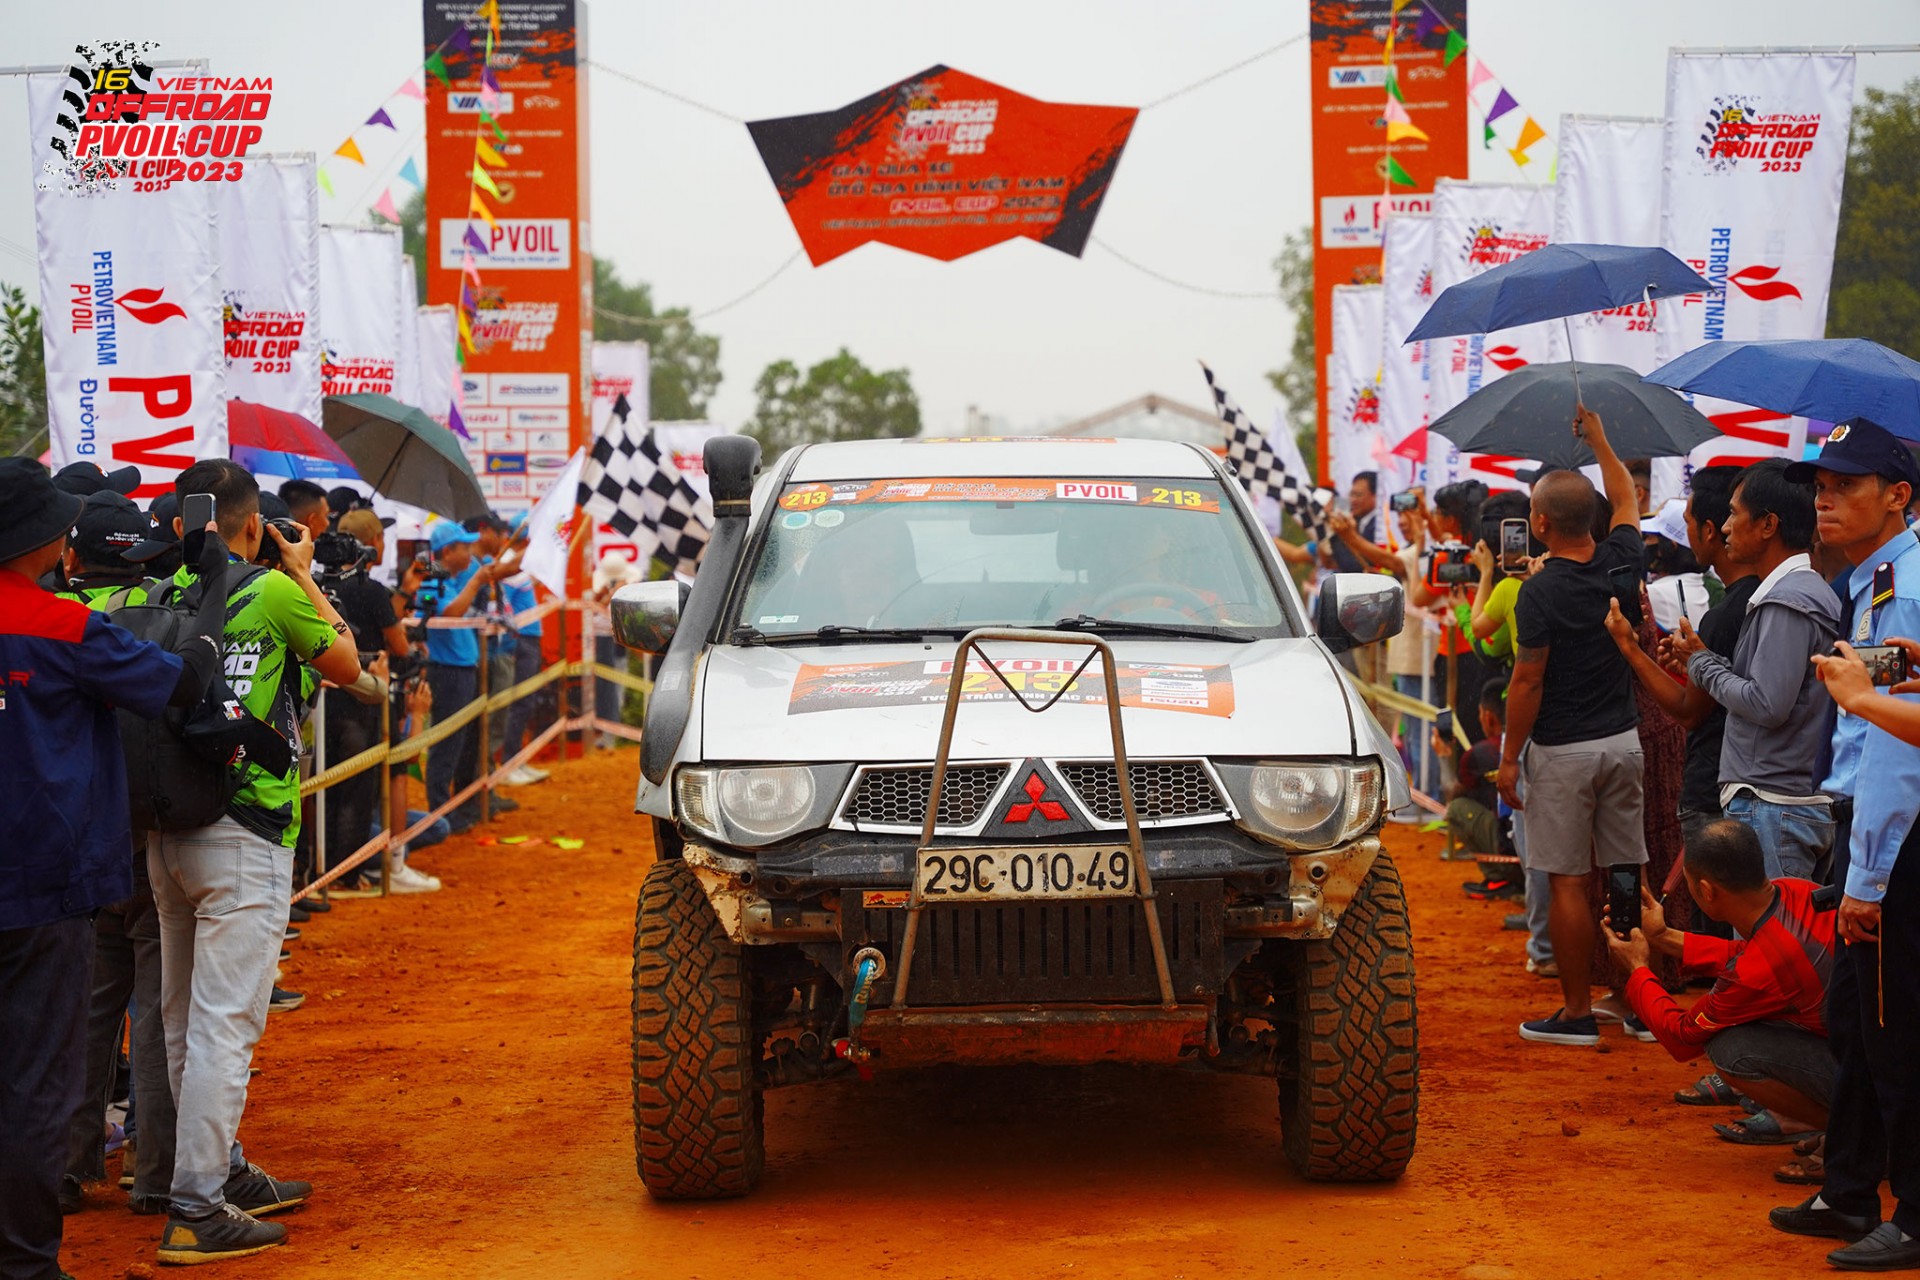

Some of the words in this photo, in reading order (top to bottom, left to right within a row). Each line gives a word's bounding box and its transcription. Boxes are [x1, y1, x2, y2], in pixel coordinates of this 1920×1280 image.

[1757, 113, 1821, 123] VIETNAM
[954, 123, 995, 142] CUP
[1717, 123, 1819, 139] OFFROAD
[1709, 141, 1768, 160] PVOIL
[1770, 141, 1814, 160] CUP
[1760, 161, 1802, 174] 2023
[489, 224, 560, 254] PVOIL
[70, 283, 93, 335] PVOIL
[92, 250, 118, 366] PETROVIETNAM
[243, 311, 306, 320] VIETNAM
[261, 339, 300, 359] CUP
[1451, 338, 1467, 374] PVOIL
[252, 361, 292, 374] 2023
[76, 378, 100, 456] Đường
[785, 491, 827, 507] 213
[1063, 484, 1130, 500] PVOIL
[1151, 487, 1202, 507] 213
[945, 671, 1079, 692] 213
